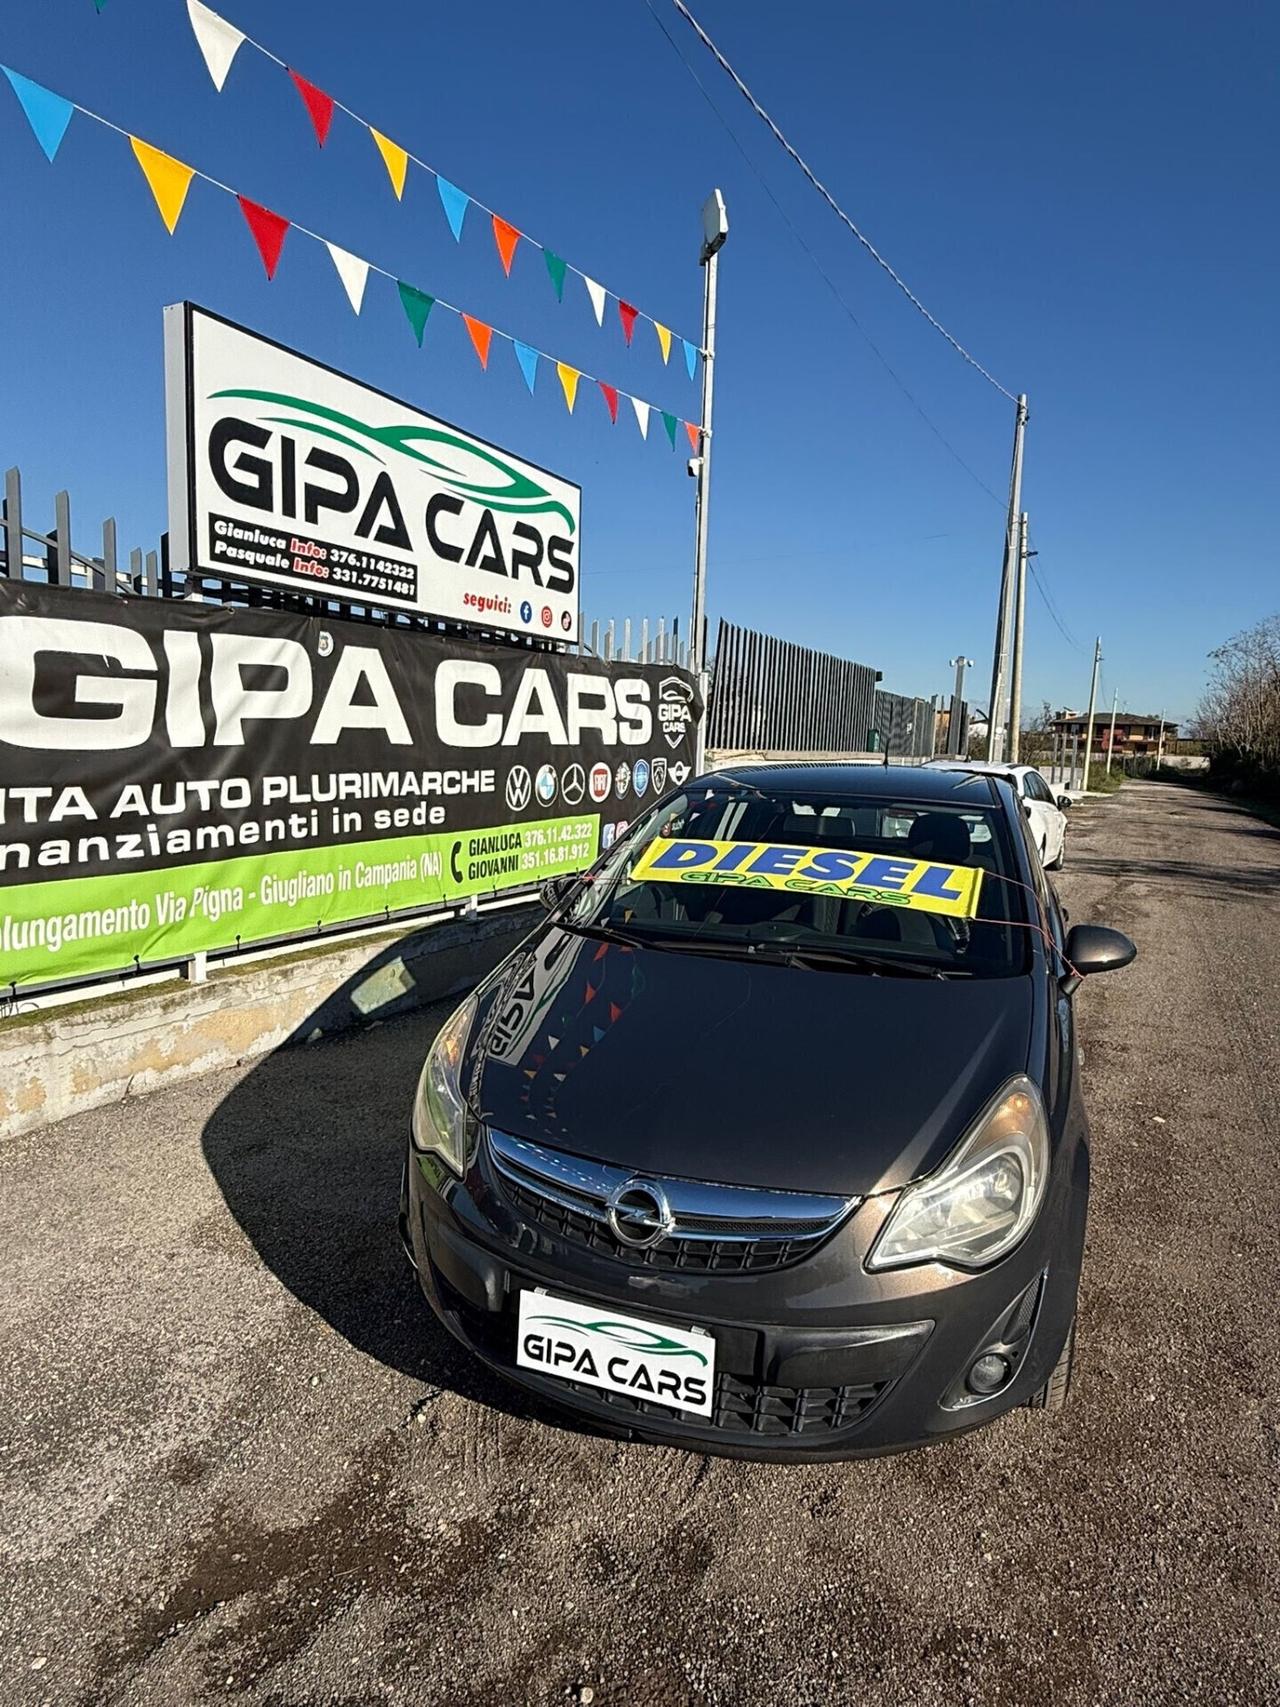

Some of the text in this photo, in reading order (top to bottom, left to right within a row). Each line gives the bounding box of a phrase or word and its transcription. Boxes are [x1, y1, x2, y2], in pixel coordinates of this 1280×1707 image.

[208, 417, 575, 594] GIPA CARS
[214, 521, 414, 579] Gianluca Info: 376.1142322
[215, 541, 415, 595] Pasquale Info: 331.7751481
[463, 592, 511, 614] seguici:
[0, 616, 652, 750] GIPA CARS
[657, 703, 692, 722] GIPA
[662, 722, 686, 733] CARS
[109, 778, 251, 819] AUTO
[263, 770, 495, 804] PLURIMARCHE
[332, 807, 361, 834] in
[374, 801, 445, 830] sede
[468, 844, 589, 880] GIOVANNI 351.16.81.912
[469, 823, 592, 857] GIANLUCA 376.11.42.322
[649, 842, 964, 900] DIESEL
[680, 871, 911, 906] GIPA CARS
[0, 902, 150, 952] lungamento
[155, 893, 187, 926] Via
[190, 886, 243, 921] Pigna
[260, 870, 334, 907] Giugliano
[338, 865, 351, 891] in
[355, 855, 417, 889] Campania
[420, 852, 443, 882] (NA)
[523, 1333, 707, 1406] GIPA CARS
